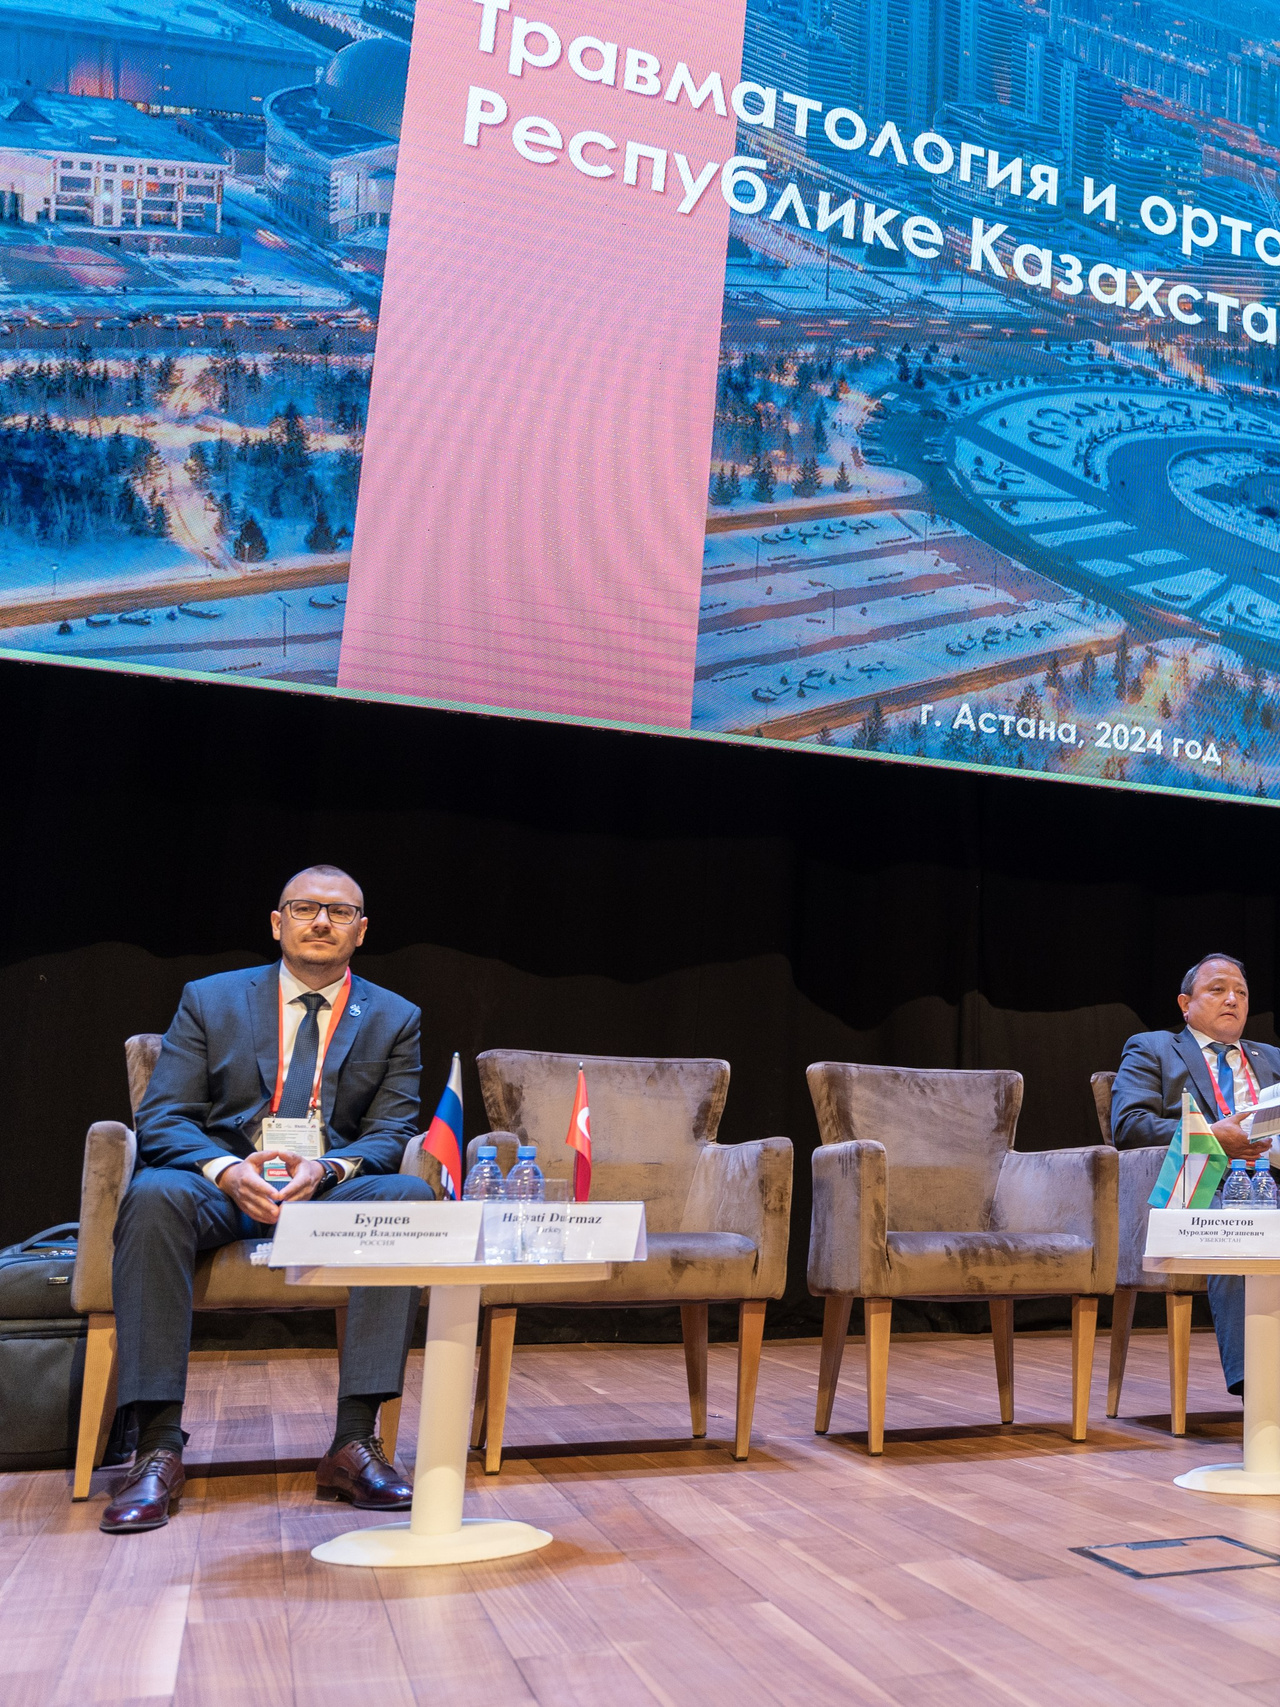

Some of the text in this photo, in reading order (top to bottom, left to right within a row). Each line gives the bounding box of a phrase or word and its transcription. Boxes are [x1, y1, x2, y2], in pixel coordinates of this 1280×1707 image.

[473, 0, 1060, 207] Травматология
[1083, 174, 1116, 223] и
[462, 85, 946, 260] Республике
[919, 703, 1222, 766] г. Астана, 2024 год
[310, 1229, 449, 1239] Александр Владимирович
[354, 1213, 411, 1228] Бурцев
[1191, 1216, 1254, 1228] Ирисметов
